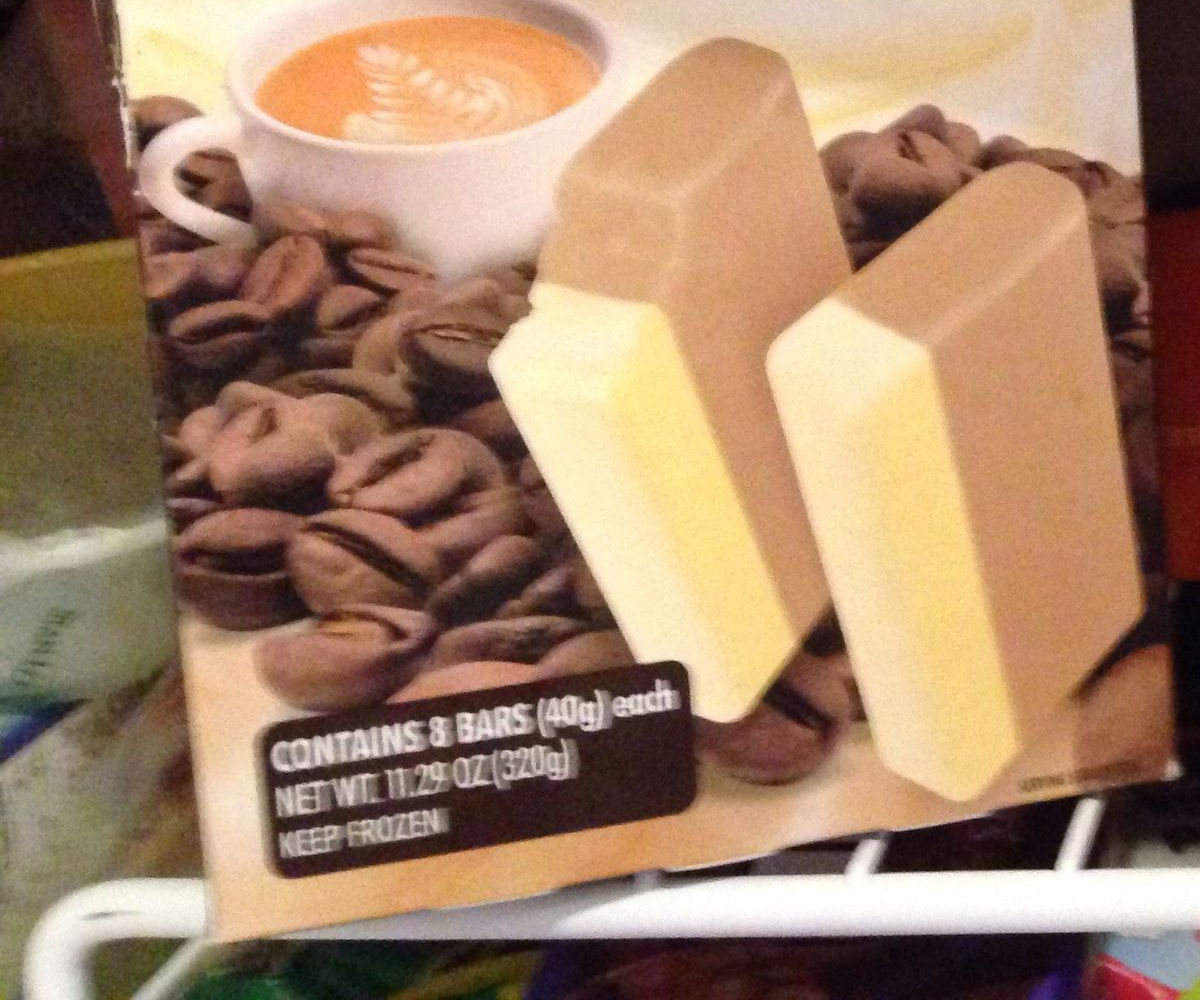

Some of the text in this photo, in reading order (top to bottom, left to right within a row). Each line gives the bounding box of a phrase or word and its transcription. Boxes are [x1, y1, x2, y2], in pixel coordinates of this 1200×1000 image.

[271, 678, 680, 773] CONTAINS 8 BARS (40g) each
[274, 779, 334, 818] NET
[452, 753, 494, 789] OZ
[492, 739, 580, 791] (320g)
[278, 807, 451, 859] KEEP FROZEN
